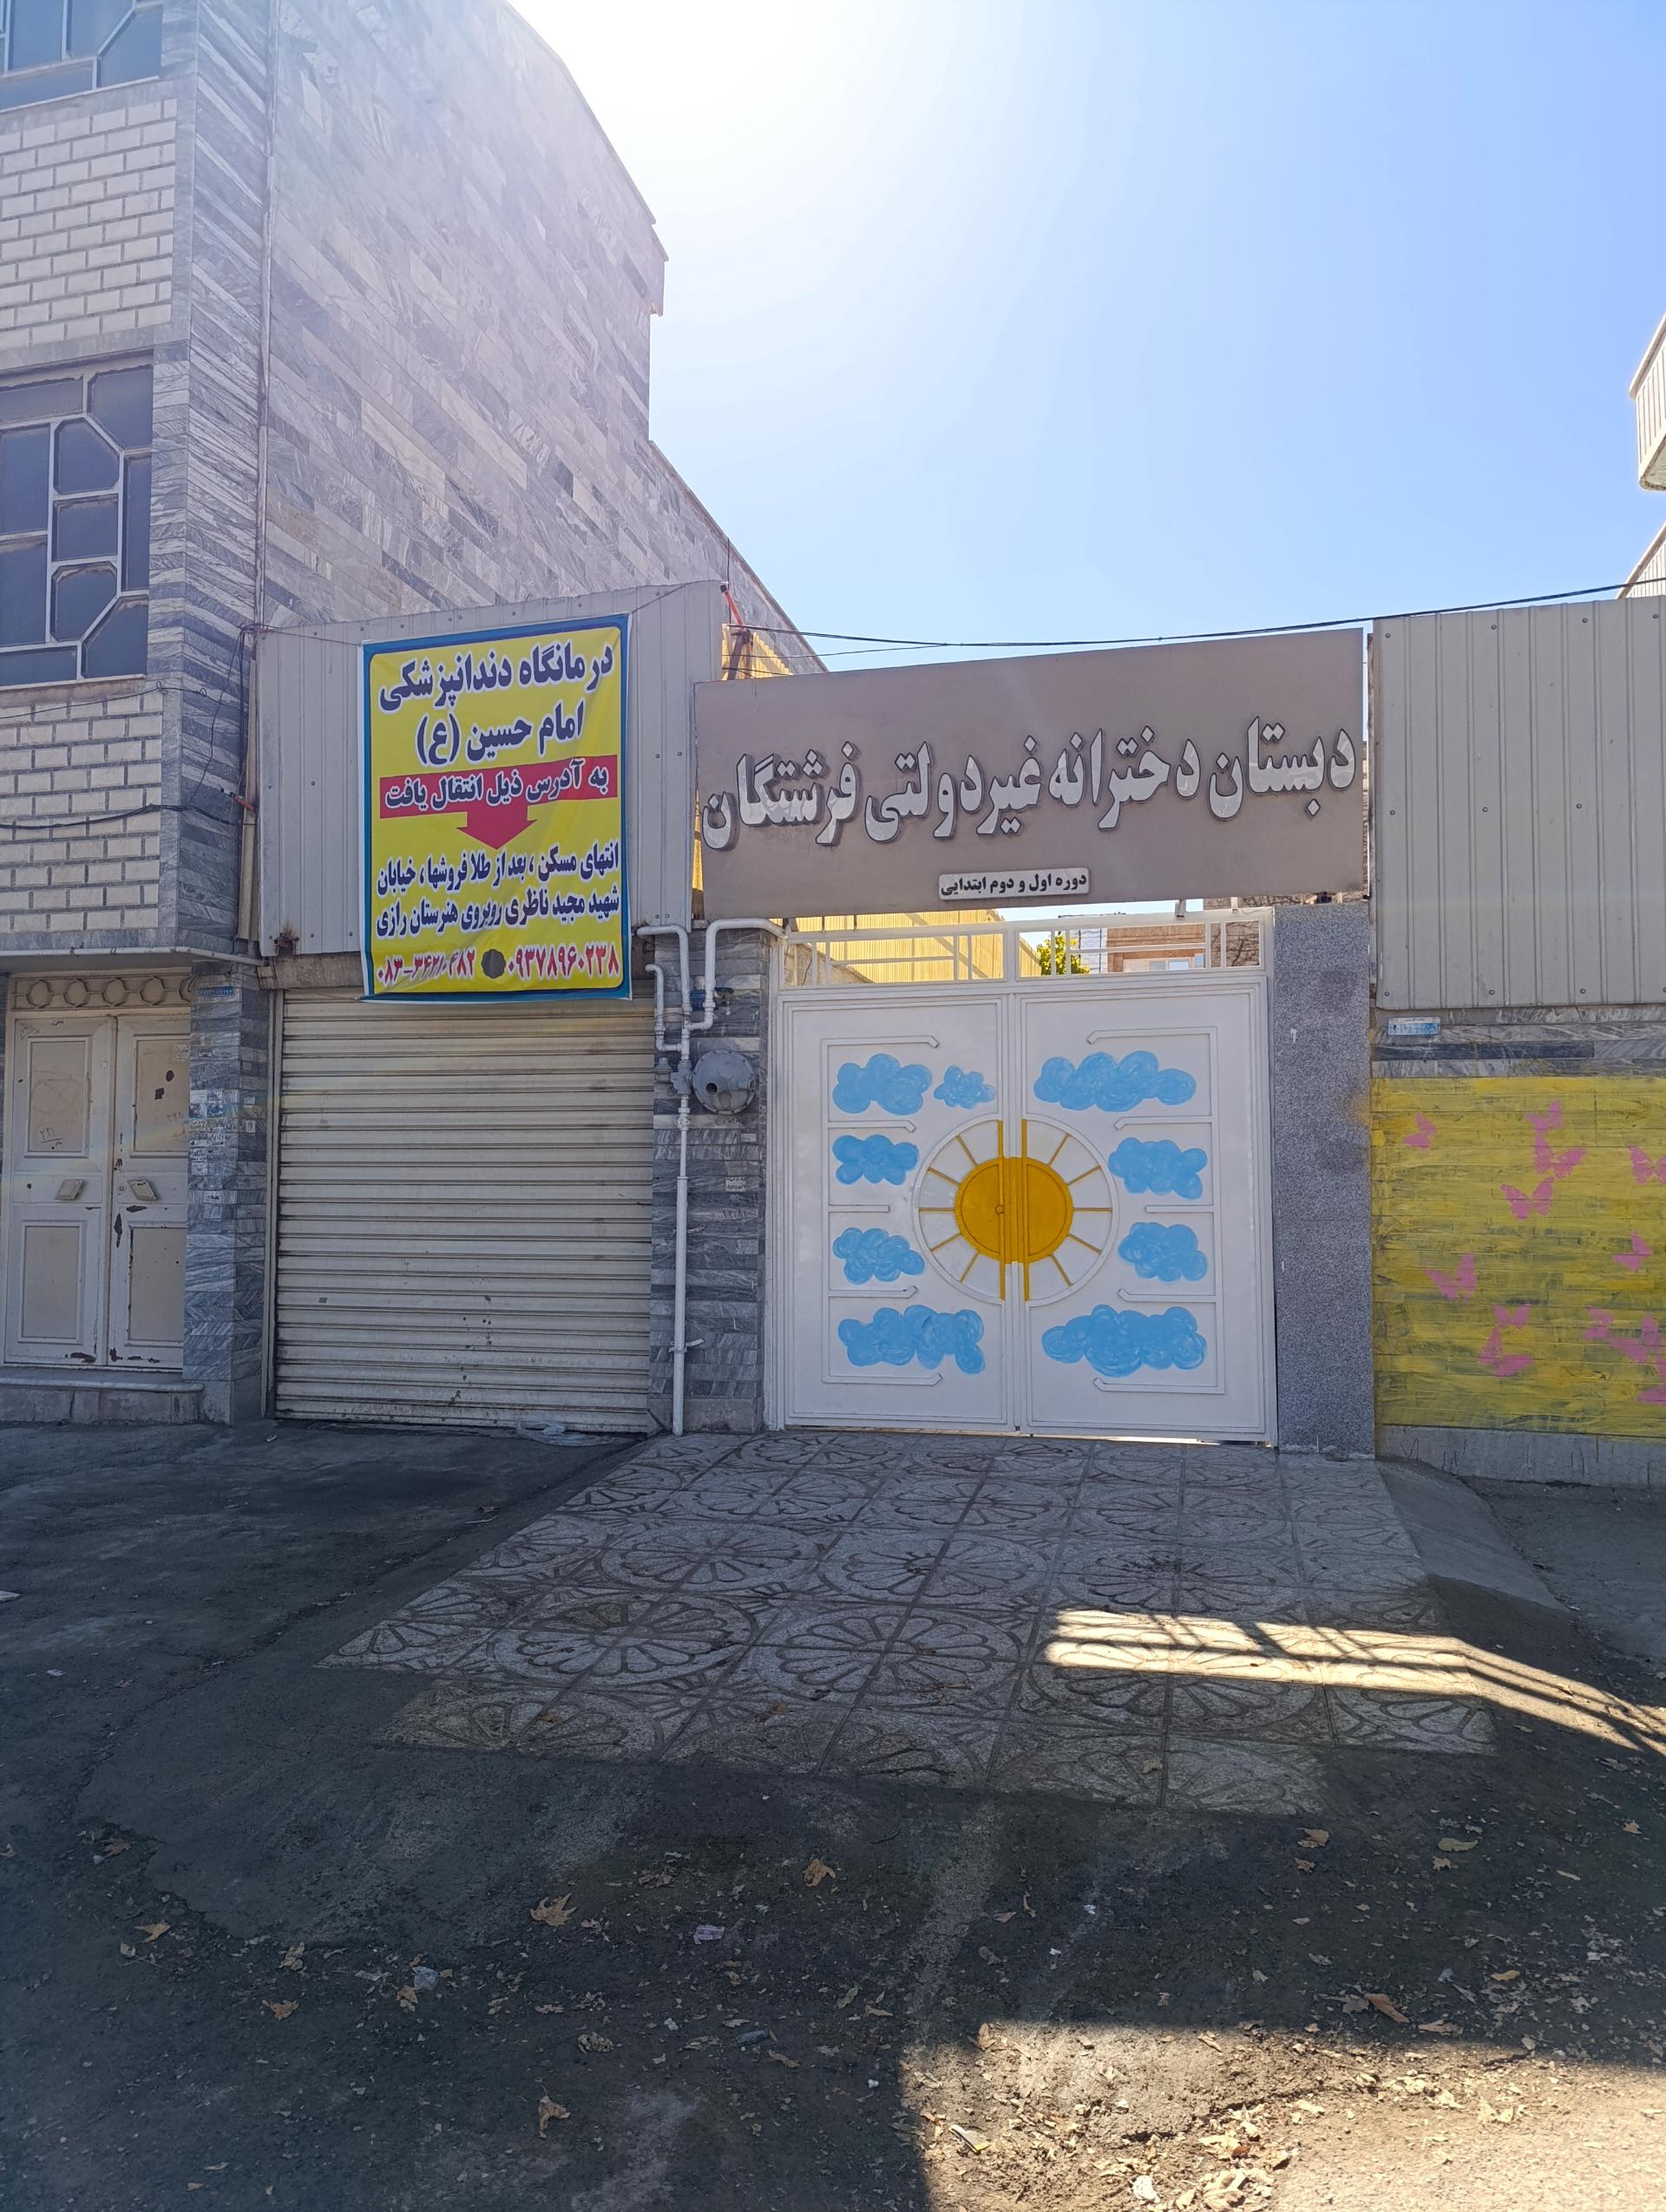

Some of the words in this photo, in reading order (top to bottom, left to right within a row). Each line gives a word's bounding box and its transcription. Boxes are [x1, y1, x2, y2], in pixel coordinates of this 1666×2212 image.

[380, 652, 511, 711] دندانپزشکی
[520, 642, 613, 690] درمانگاه
[416, 713, 460, 765] (ع)
[466, 717, 532, 762] حسین
[539, 700, 584, 755] امام
[527, 758, 585, 801] آدرس
[589, 766, 609, 794] به
[1047, 724, 1203, 831] دخترانه
[1208, 716, 1356, 821] دبستان
[385, 778, 427, 810] یافت
[432, 774, 482, 808] انتقال
[487, 769, 522, 804] ذیل
[701, 741, 859, 851] فرشتگان
[377, 859, 416, 895] خیابان
[492, 851, 506, 886] از
[508, 855, 526, 880] بعد
[580, 842, 619, 880] انتهای
[941, 876, 987, 896] ابتدایی
[989, 878, 1014, 893] دوم
[1018, 880, 1026, 893] و
[1029, 873, 1052, 892] اول
[1055, 874, 1087, 890] دوره
[377, 900, 407, 936] رازی
[410, 899, 458, 934] هنرستان
[461, 901, 502, 930] روبروی
[505, 888, 548, 926] ناظری
[552, 894, 585, 922] مجید
[588, 885, 619, 919] شهید
[508, 944, 620, 978] ۰۹۳۷۸۹۶۰۲۳۸
